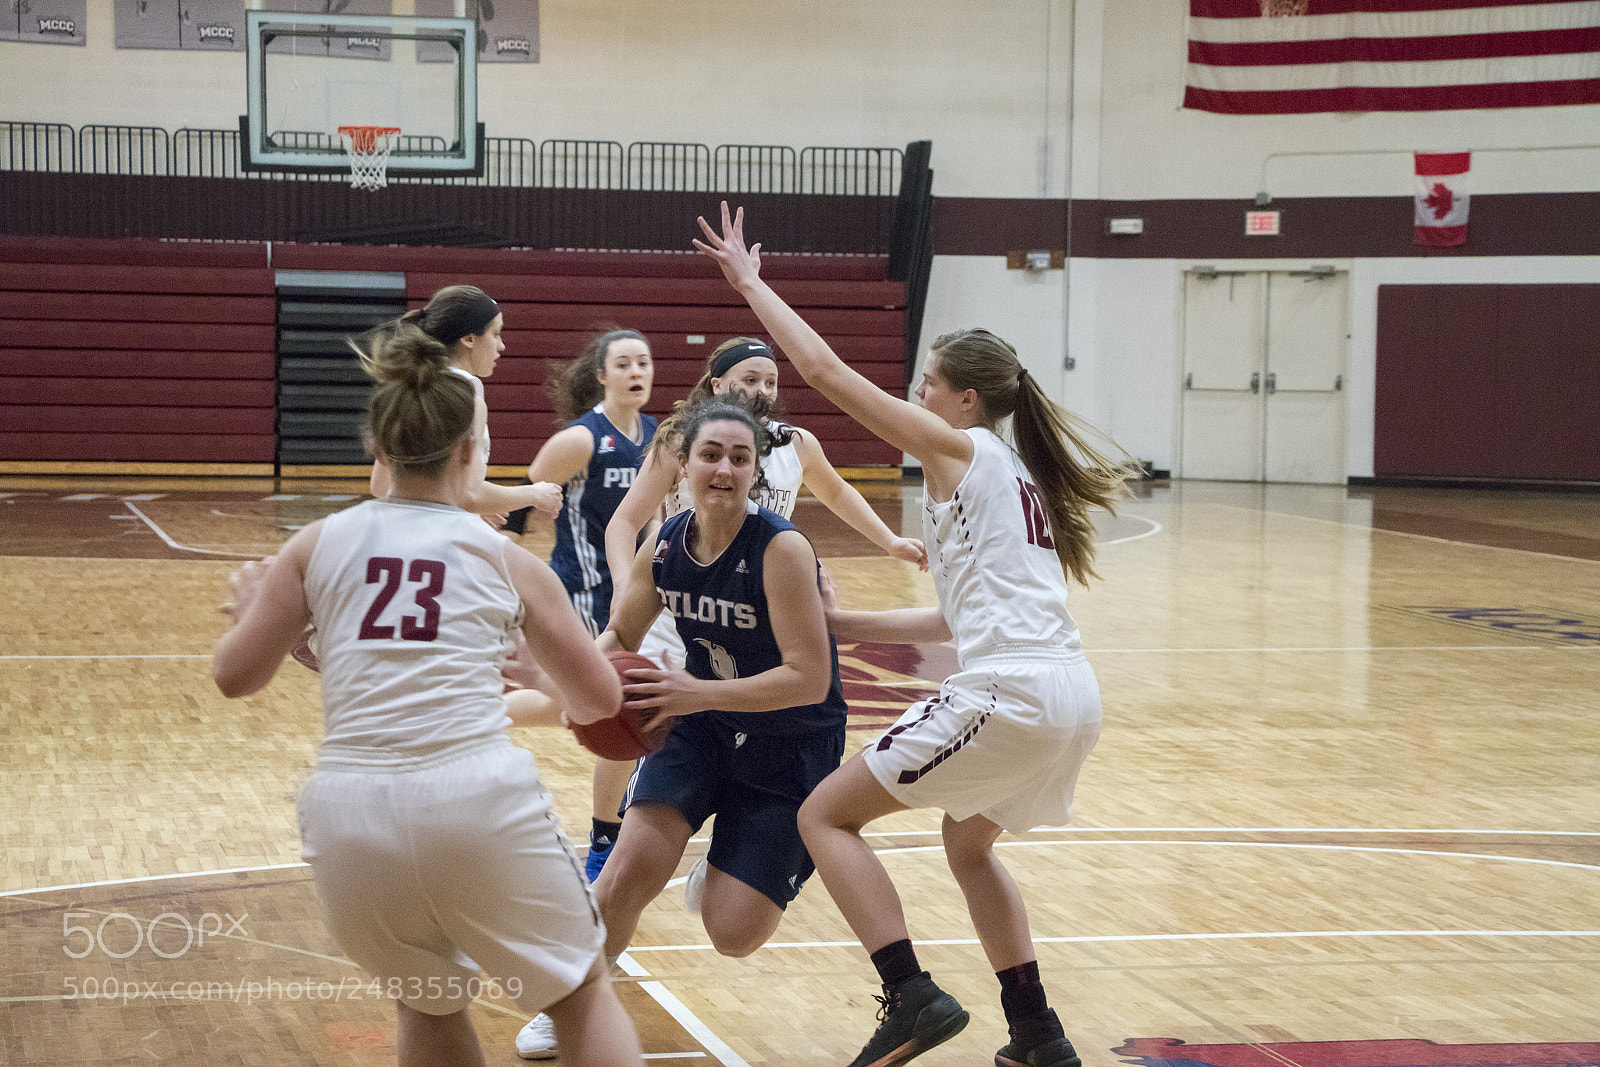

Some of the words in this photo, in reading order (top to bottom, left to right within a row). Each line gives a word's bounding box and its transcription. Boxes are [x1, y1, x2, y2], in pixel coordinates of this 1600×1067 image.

[39, 19, 75, 32] MCCC
[200, 26, 234, 38] MCCC
[497, 39, 529, 50] MCCC
[1016, 476, 1055, 550] 10
[358, 557, 446, 642] 23
